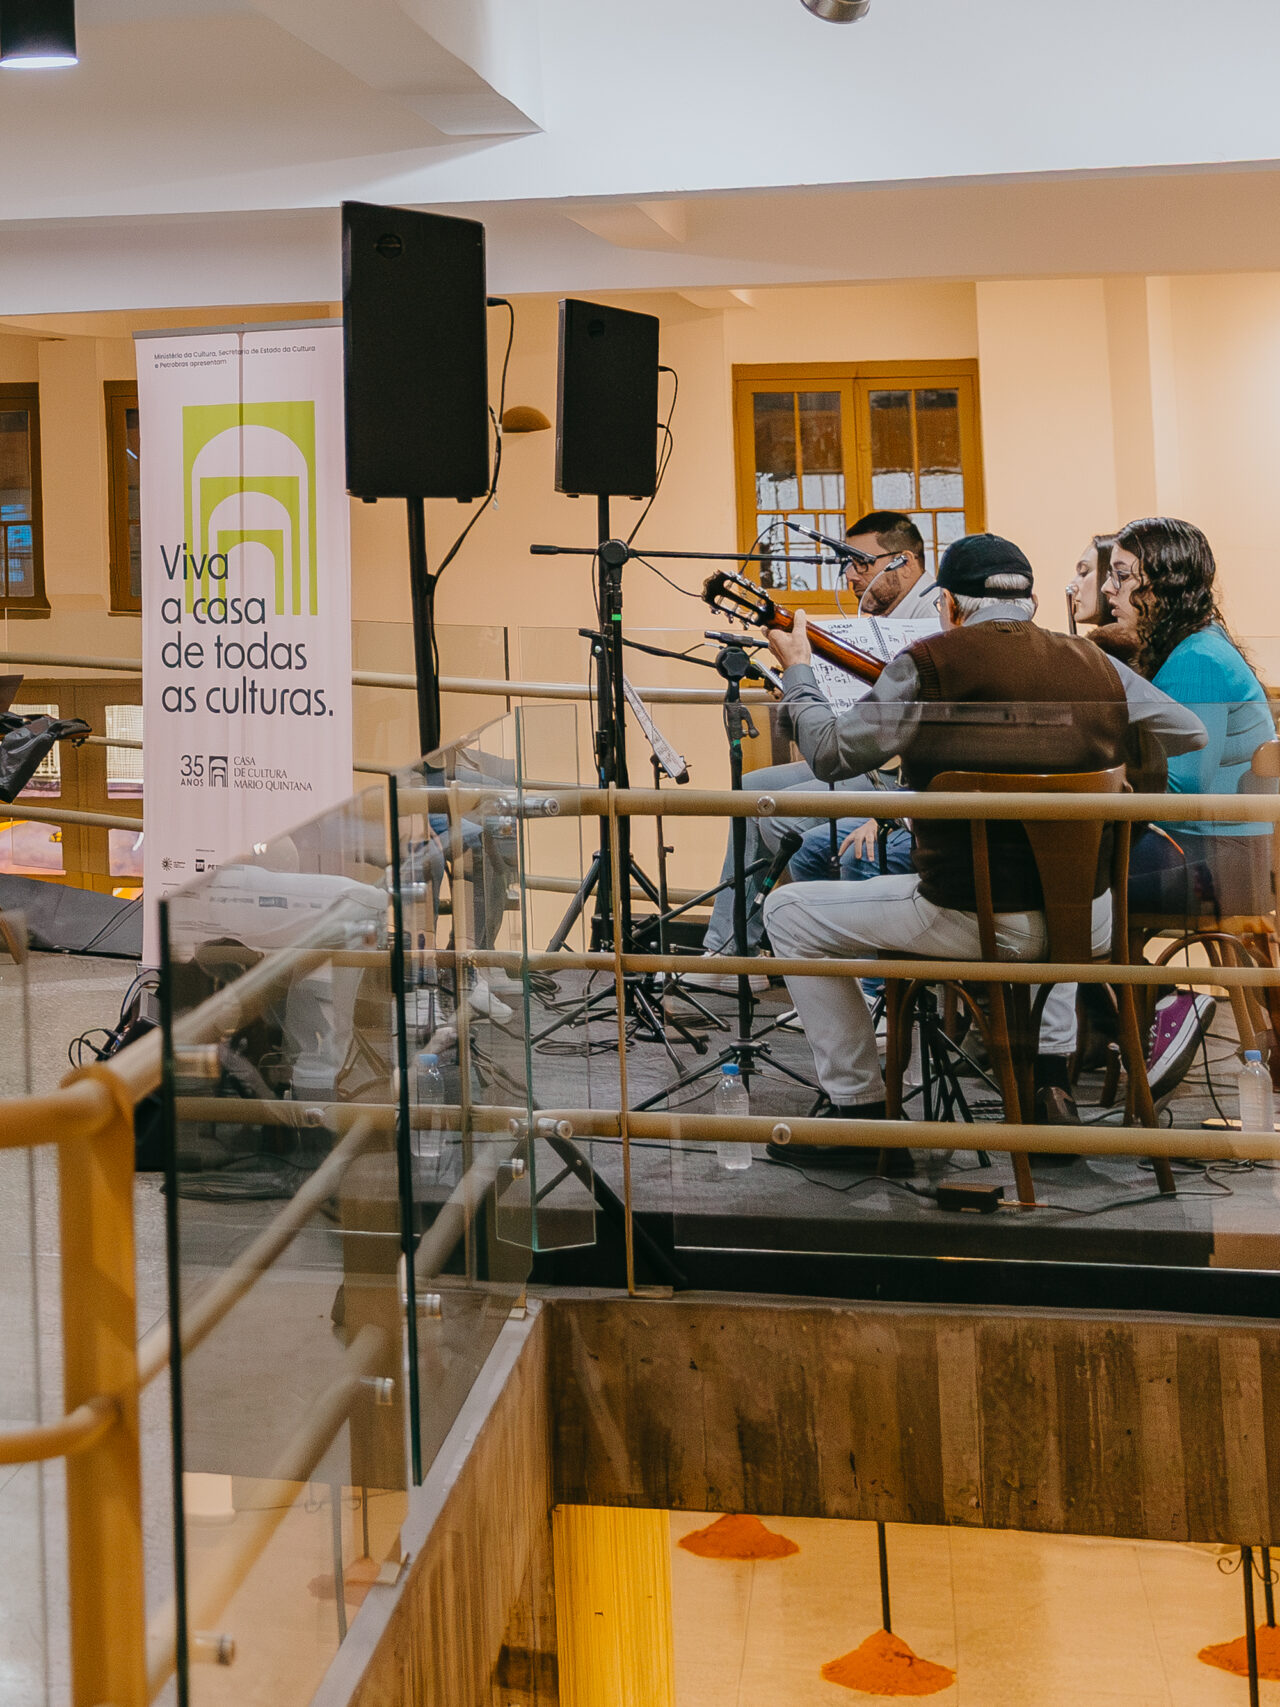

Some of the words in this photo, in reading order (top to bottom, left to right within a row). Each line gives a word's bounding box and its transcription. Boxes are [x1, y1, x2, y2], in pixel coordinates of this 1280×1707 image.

[193, 350, 217, 358] Cultura,
[190, 359, 227, 368] apresentam
[160, 542, 229, 580] Viva
[161, 597, 181, 624] a
[192, 597, 265, 624] casa
[161, 630, 204, 669] de
[214, 631, 307, 670] todas
[161, 685, 197, 713] as
[206, 676, 333, 717] culturas.
[180, 754, 204, 777] 35
[233, 756, 256, 766] CASA
[233, 767, 246, 778] DE
[247, 768, 288, 779] CULTURA
[180, 778, 204, 787] ANOS
[233, 780, 264, 790] MARIO
[265, 780, 313, 792] QUINTANA
